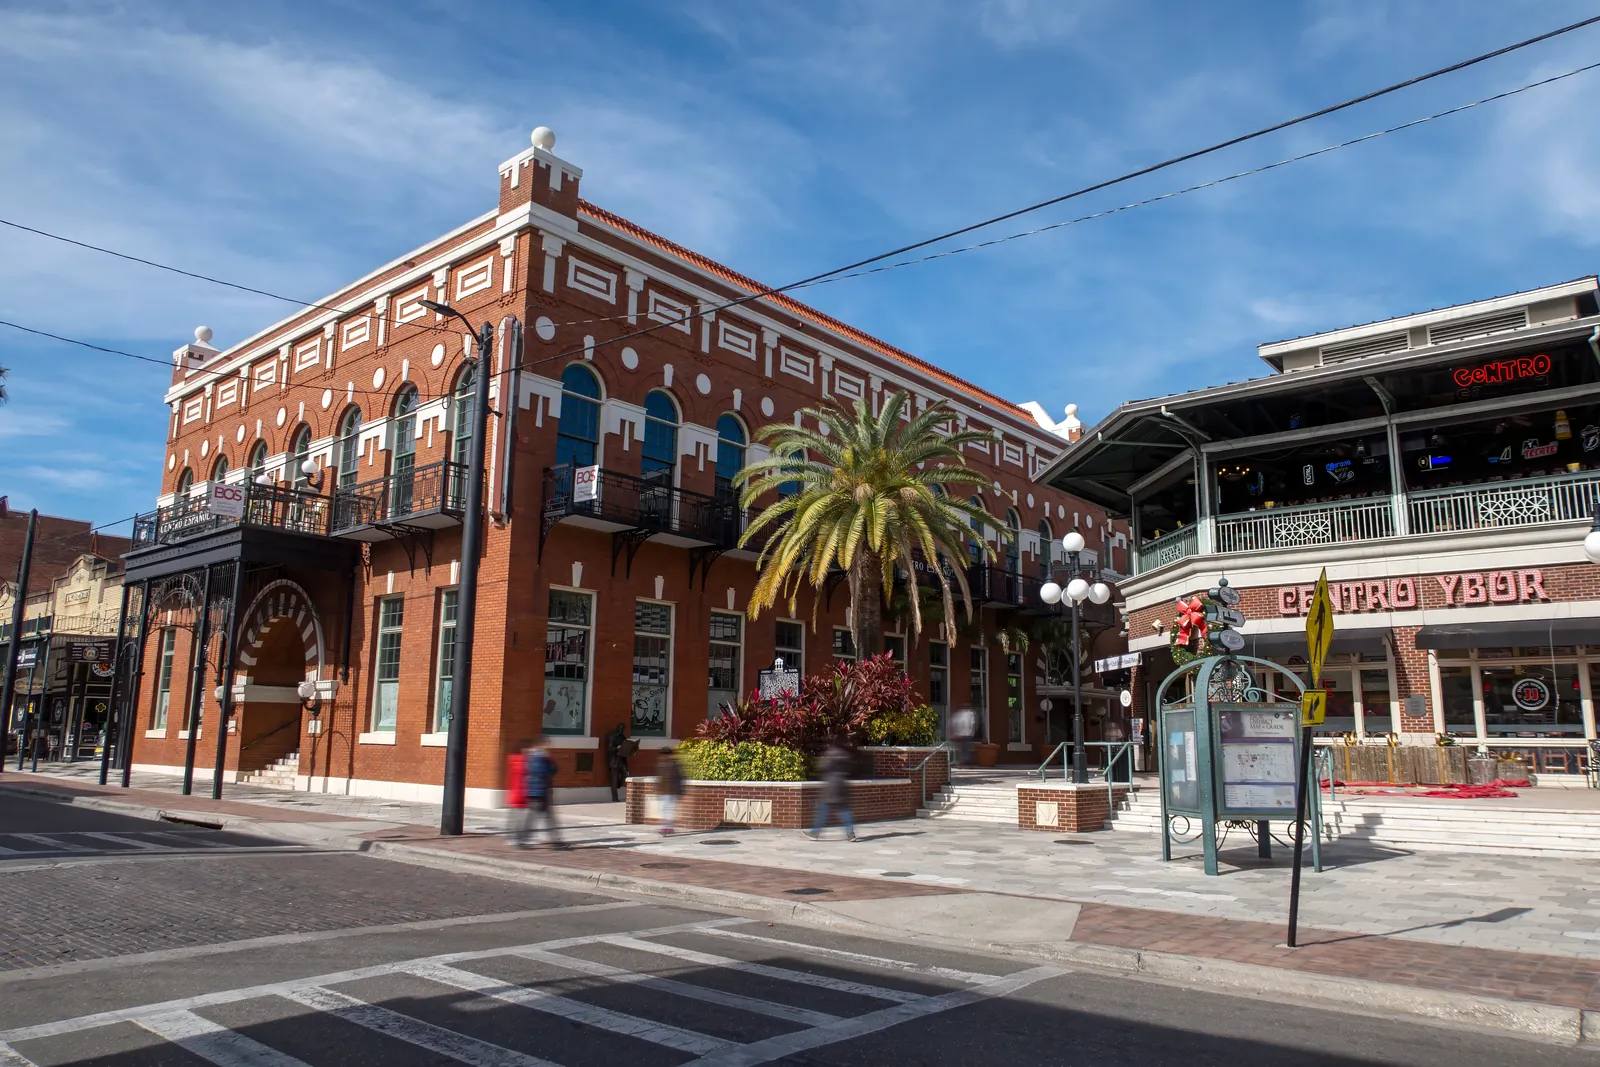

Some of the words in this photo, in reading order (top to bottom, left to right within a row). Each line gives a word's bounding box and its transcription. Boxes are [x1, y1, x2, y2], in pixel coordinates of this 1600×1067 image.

[1524, 445, 1558, 458] TECATE
[1325, 460, 1352, 471] Corona
[577, 469, 596, 485] BOS
[214, 486, 242, 501] BOS
[1278, 578, 1417, 614] CENTRO
[1435, 569, 1550, 605] YBOR
